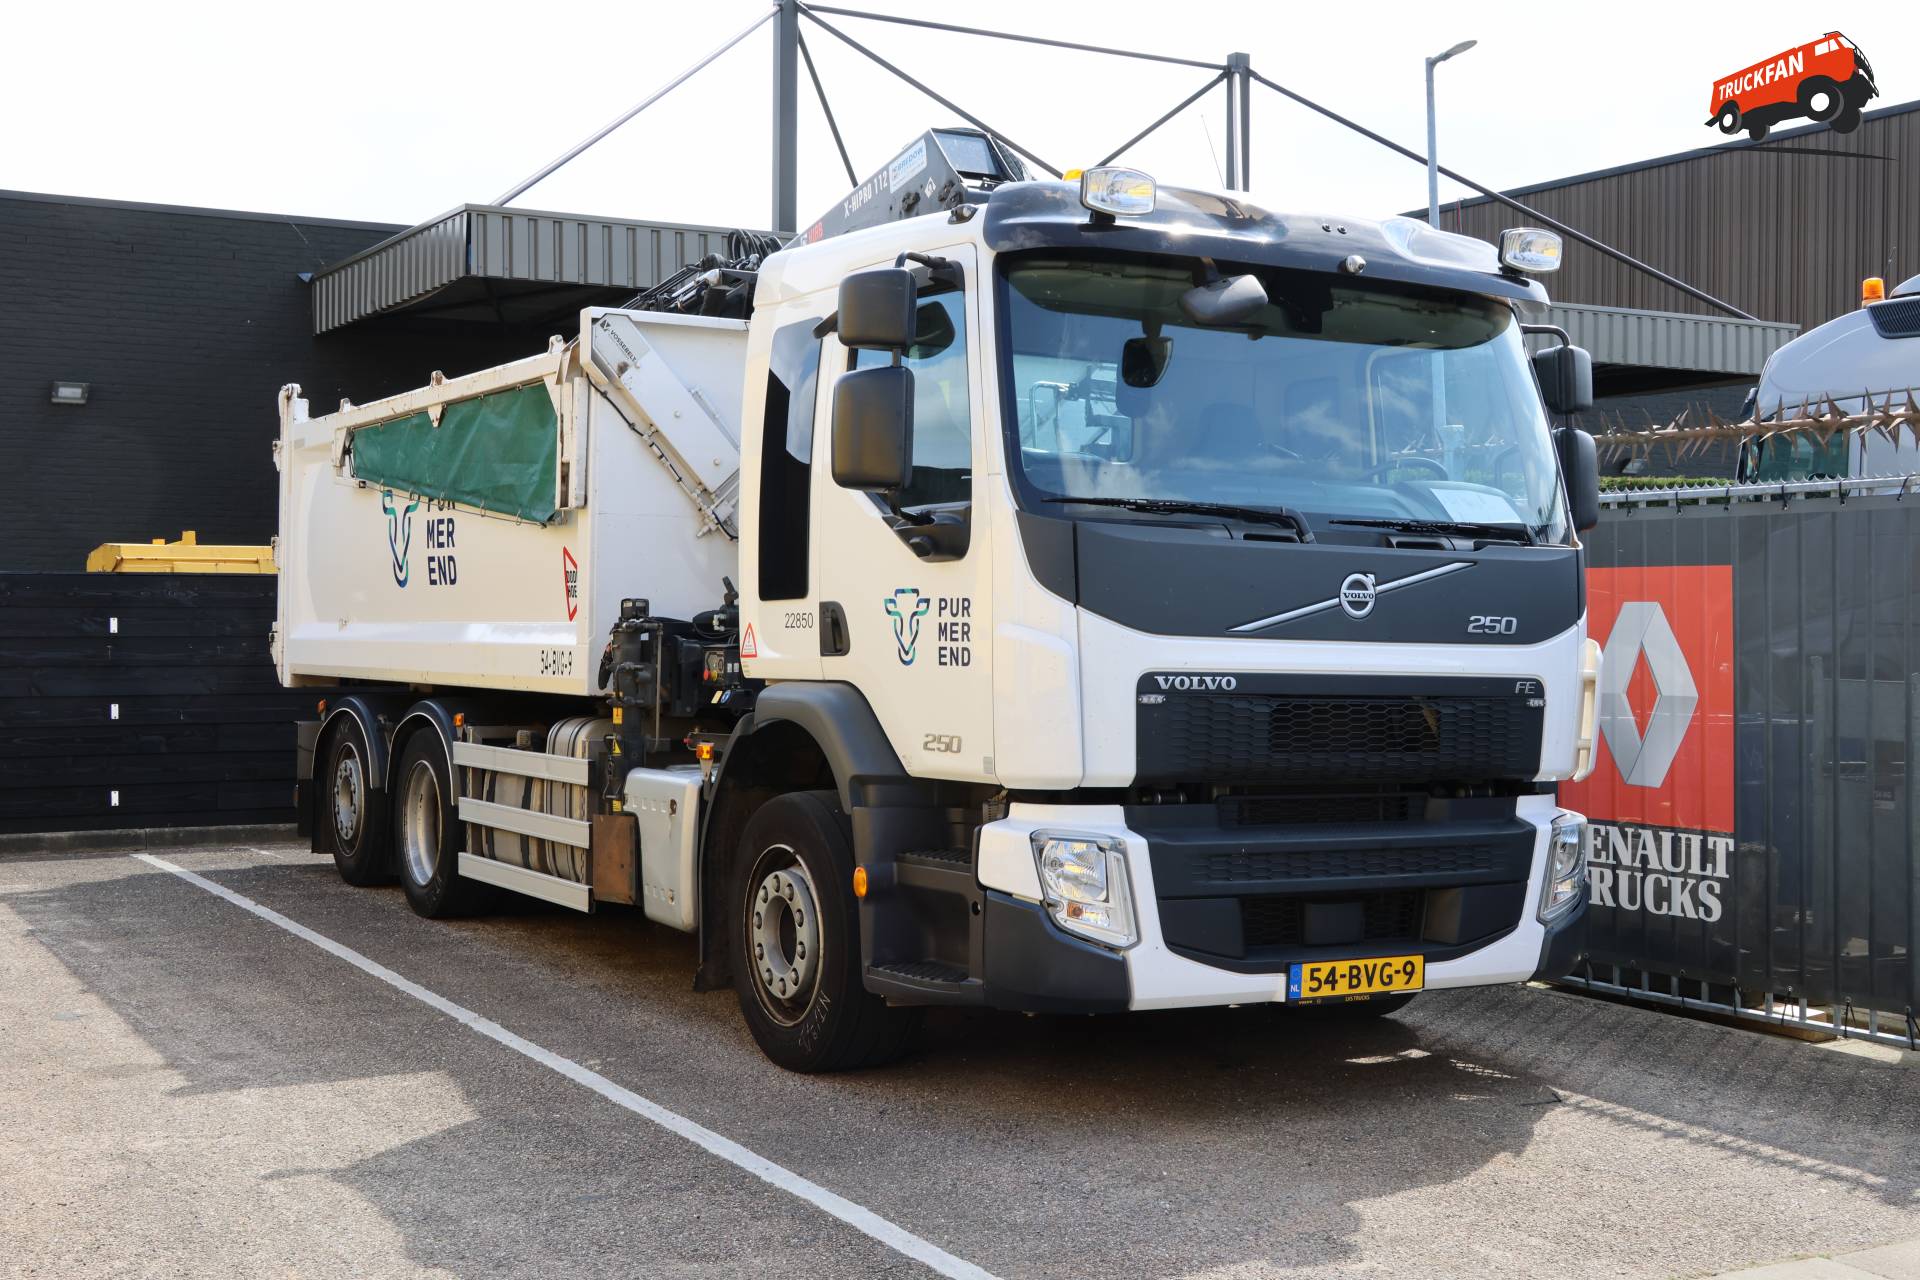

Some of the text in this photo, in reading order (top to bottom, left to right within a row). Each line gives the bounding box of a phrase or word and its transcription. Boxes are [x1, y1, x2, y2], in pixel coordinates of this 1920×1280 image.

[844, 183, 872, 219] X-HIPRO
[873, 170, 888, 195] 112
[427, 518, 455, 549] MER
[427, 555, 457, 586] END
[568, 585, 578, 598] HOE
[938, 597, 971, 618] PUR
[784, 612, 814, 629] 22850
[1467, 615, 1518, 635] 250
[938, 622, 971, 642] MER
[540, 650, 573, 676] 54-BVG-9
[938, 646, 971, 666] END
[1153, 675, 1237, 691] VOLVO
[1515, 681, 1537, 694] FE
[922, 733, 962, 753] 250
[1586, 823, 1735, 878] ENAULT
[1587, 866, 1723, 923] RUCKS
[1308, 960, 1416, 993] 54-BVG-9
[1290, 984, 1300, 993] NL
